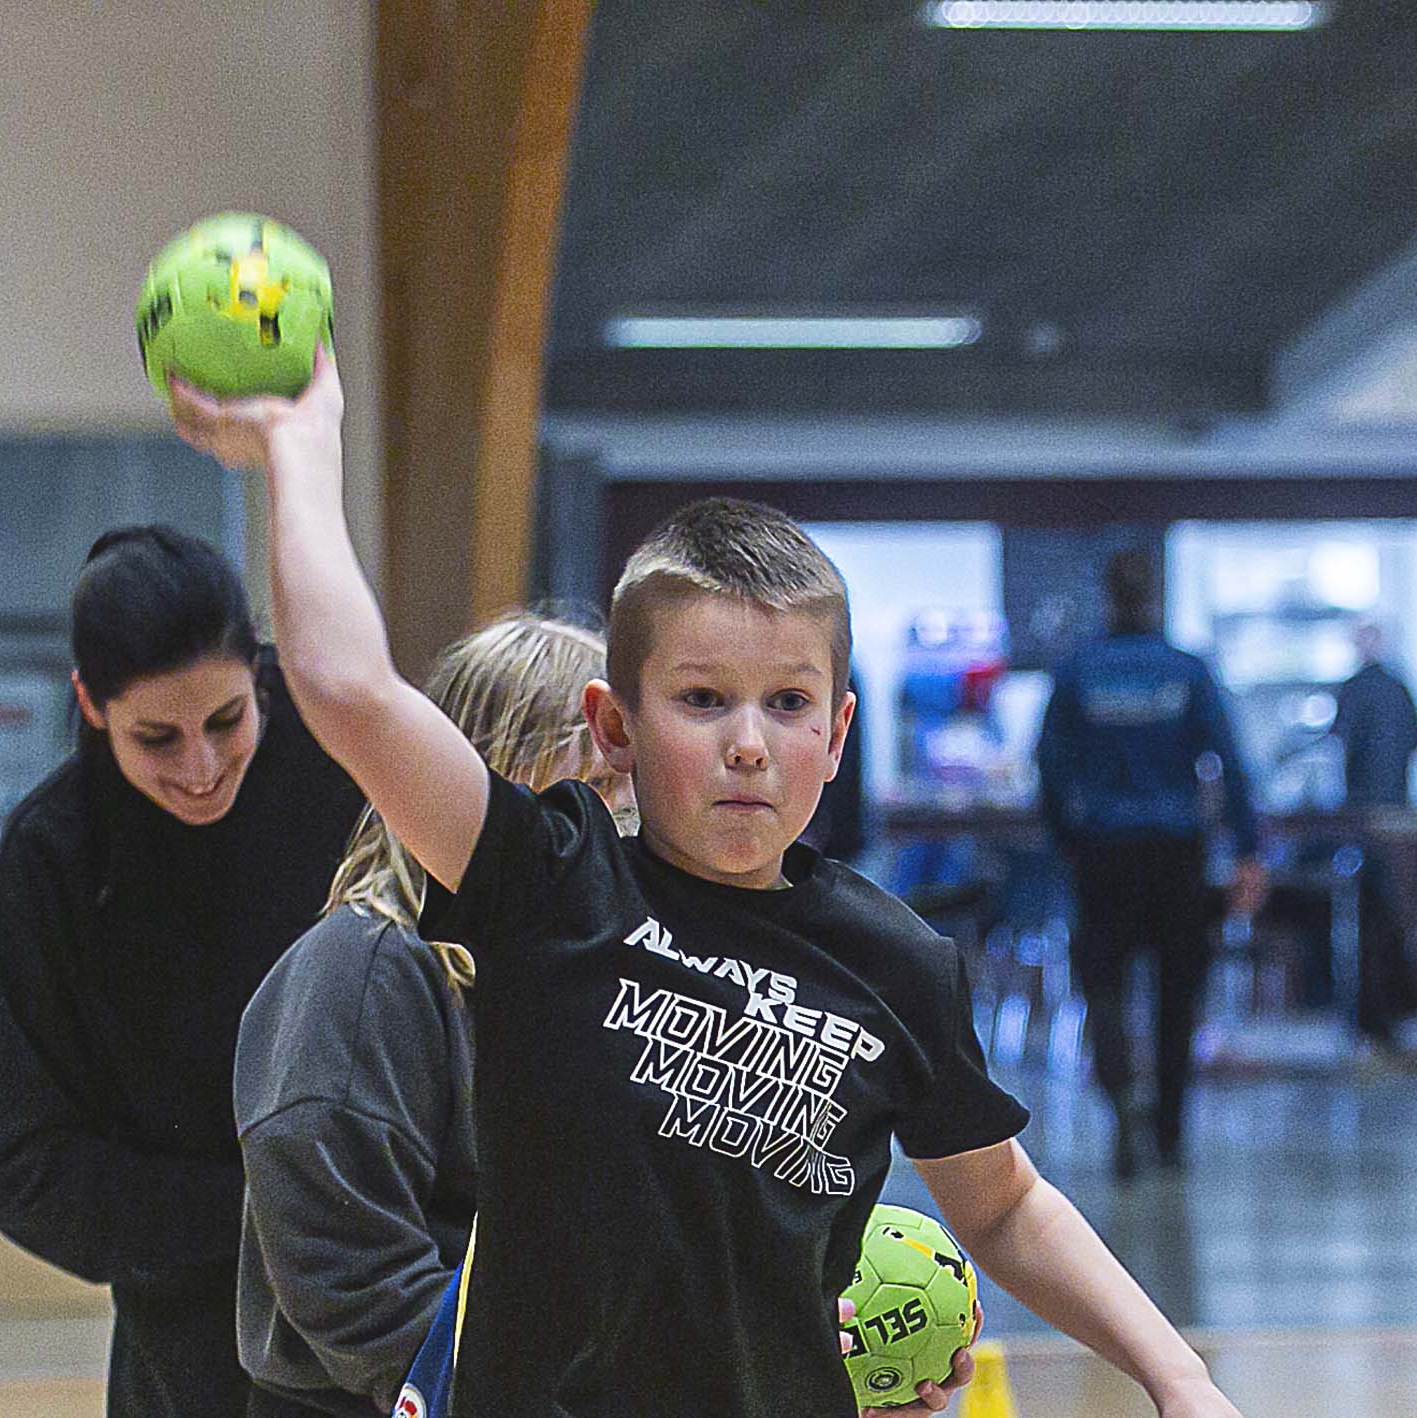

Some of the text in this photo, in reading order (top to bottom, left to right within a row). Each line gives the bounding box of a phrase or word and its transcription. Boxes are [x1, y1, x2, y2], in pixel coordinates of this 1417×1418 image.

[623, 916, 798, 1004] ALWAYS
[603, 978, 850, 1100] MOVING
[743, 993, 886, 1062] KEEP
[630, 1037, 848, 1152] MOVING
[658, 1095, 856, 1196] MOVING
